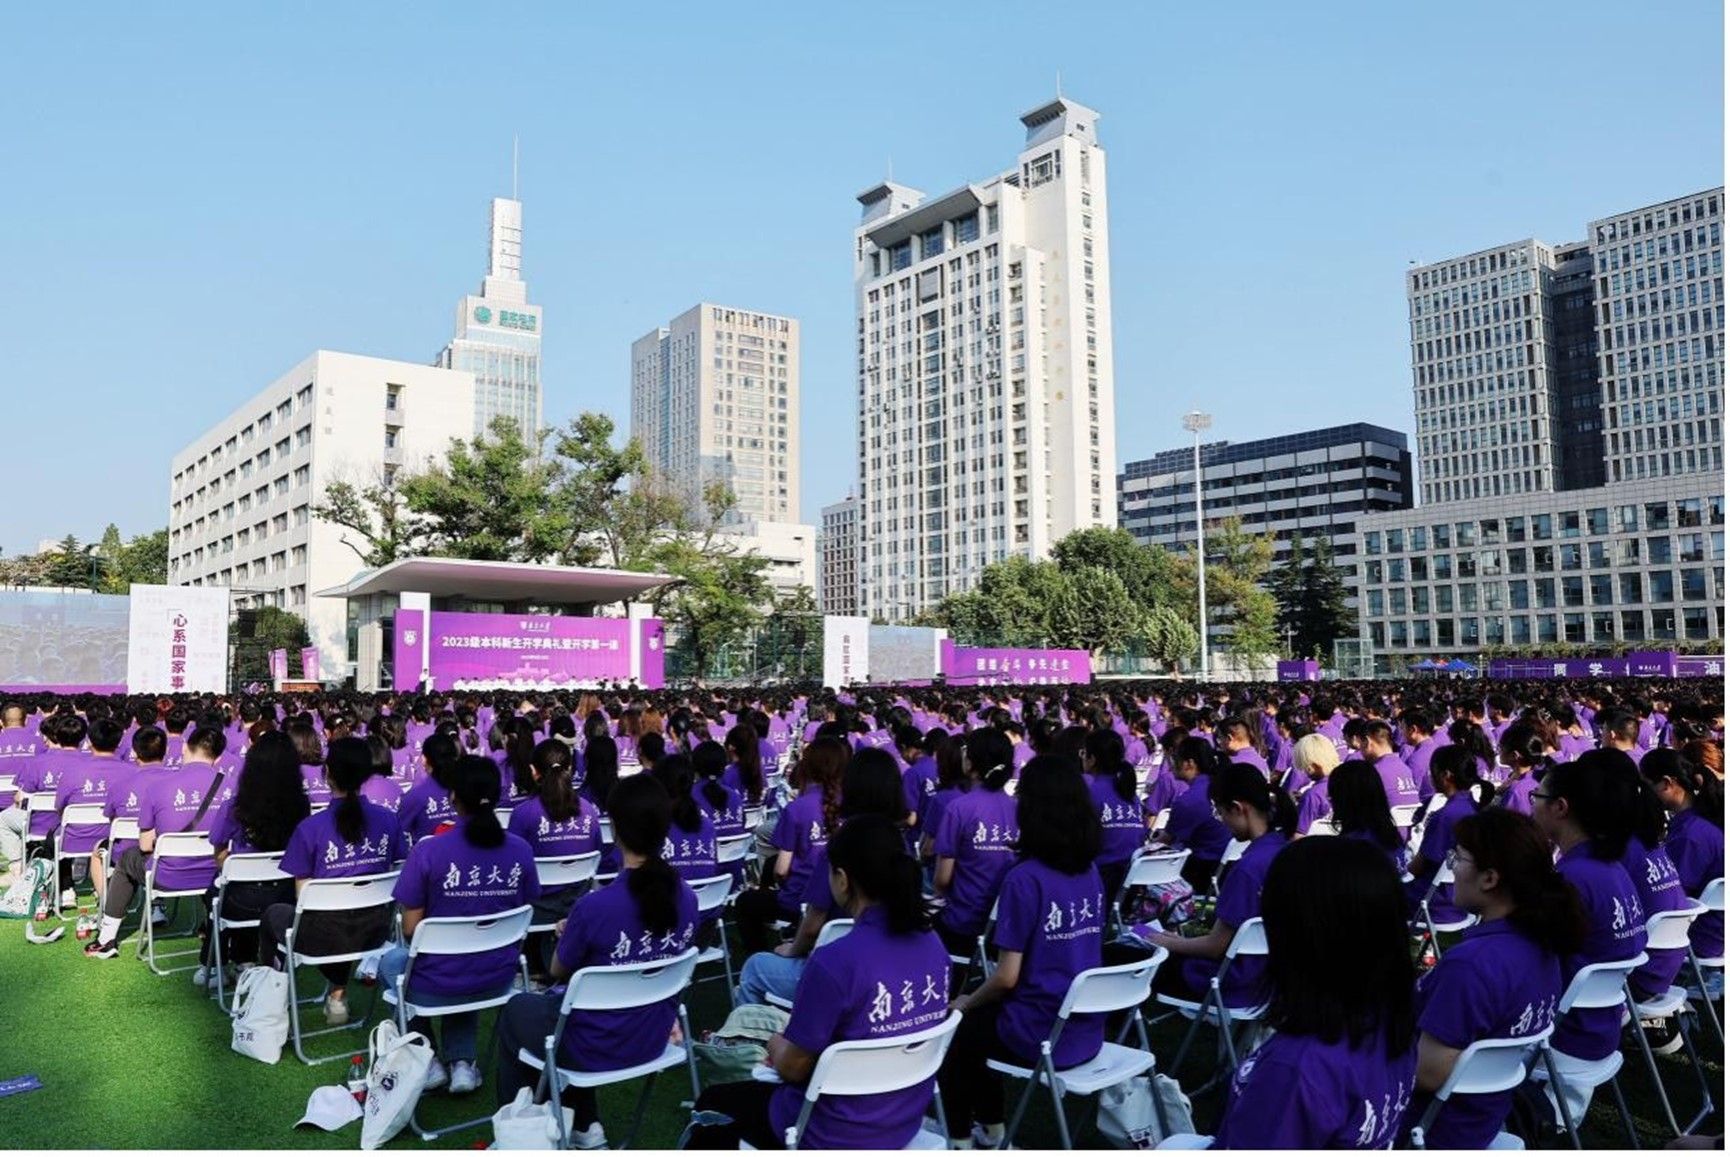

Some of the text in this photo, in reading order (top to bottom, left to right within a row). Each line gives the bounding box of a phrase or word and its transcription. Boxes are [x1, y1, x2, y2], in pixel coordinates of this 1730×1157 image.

[171, 613, 188, 690] 心系国家事
[83, 779, 107, 794] 南京
[973, 821, 1020, 844] 南京大
[443, 862, 522, 890] 南京大学
[1646, 855, 1679, 884] 南京大
[1044, 893, 1103, 932] 南大
[1510, 994, 1556, 1036] 南京大
[1356, 1075, 1416, 1147] 南京大
